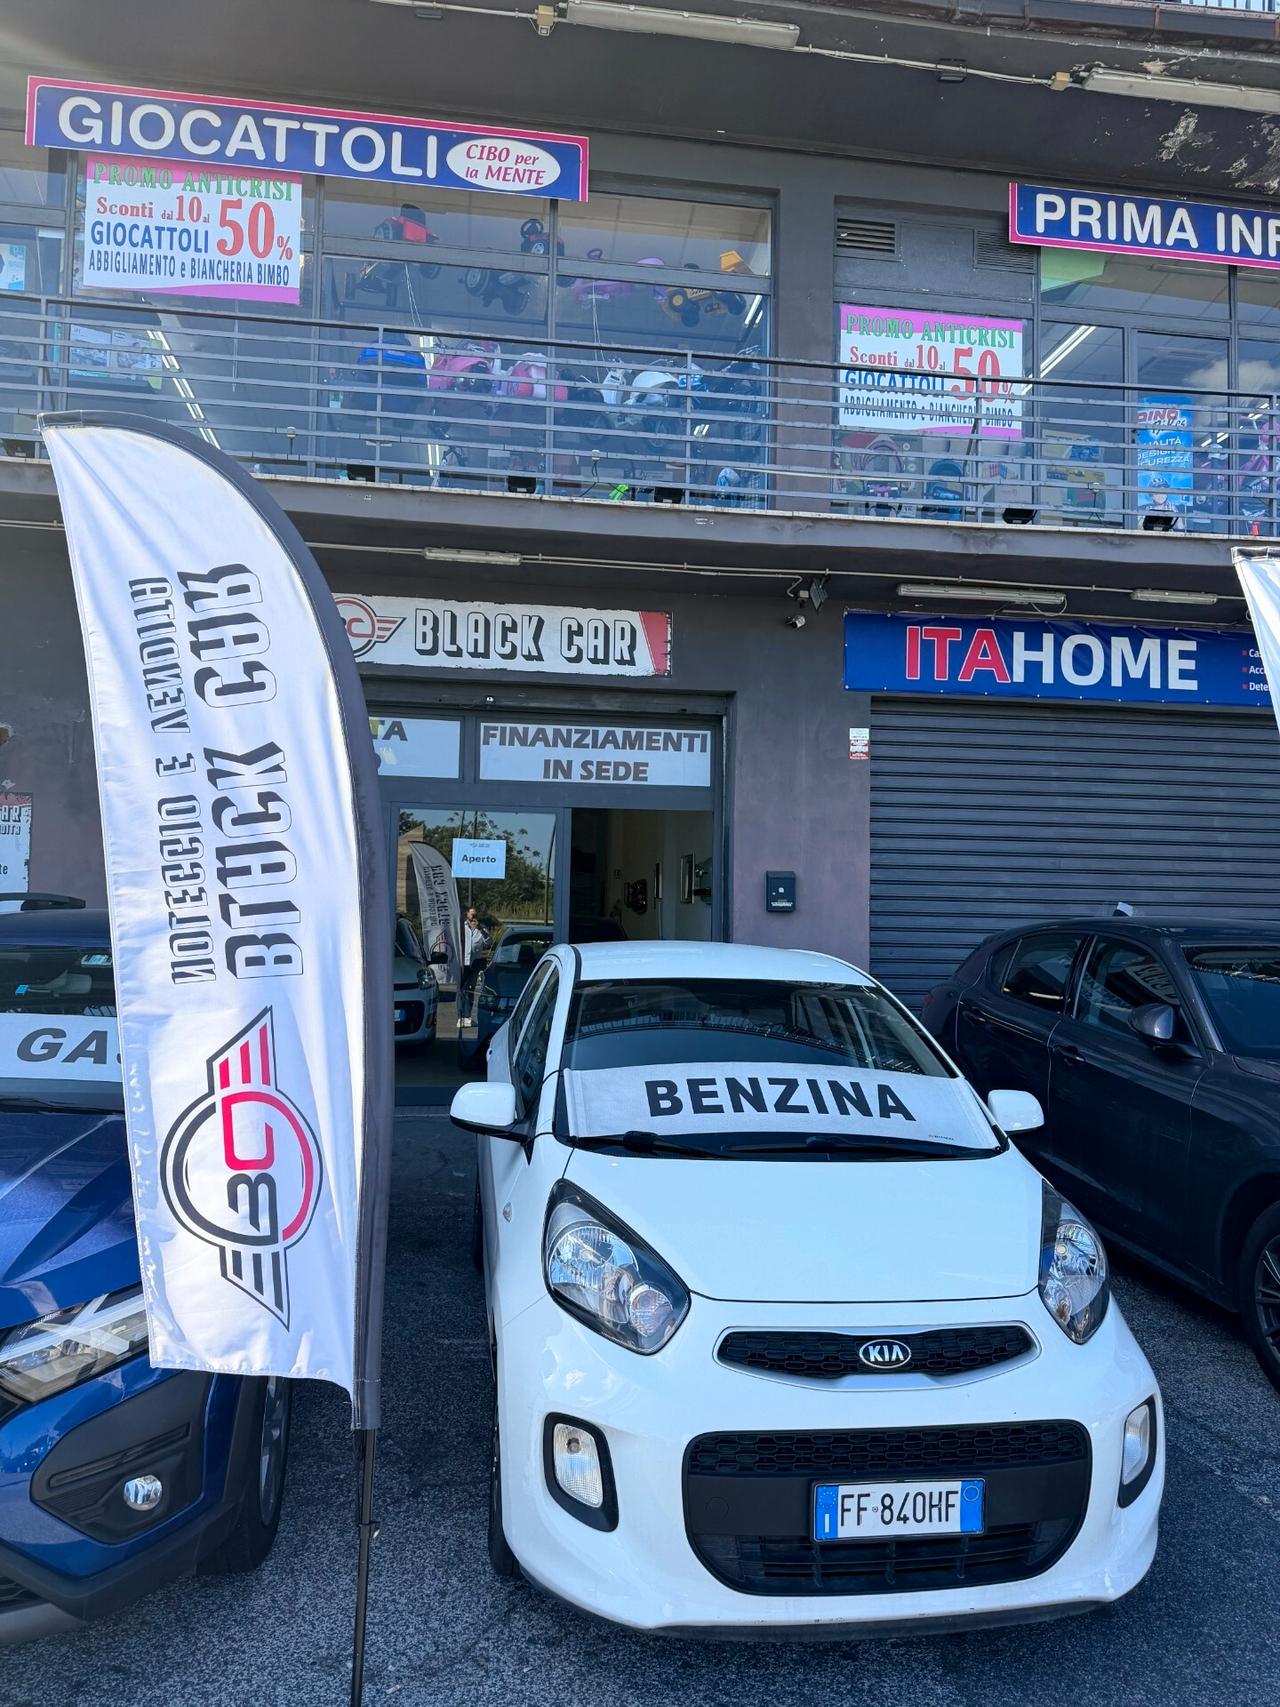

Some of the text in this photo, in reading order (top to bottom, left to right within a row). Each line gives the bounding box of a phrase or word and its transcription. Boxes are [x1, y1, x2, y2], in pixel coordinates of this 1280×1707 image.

[58, 96, 438, 178] GIOCATTOLI
[466, 144, 539, 166] CIBO per
[93, 162, 292, 201] PROMO ANTICRISI
[465, 165, 546, 185] la MENTE
[96, 197, 154, 219] Sconti
[161, 209, 174, 221] dal
[176, 195, 202, 223] 10
[202, 214, 210, 224] al
[1035, 193, 1199, 248] PRIMA
[90, 220, 209, 253] GIOCATTOLI
[89, 249, 290, 286] ABBIGLIAMENTO e BIANCHERIA BIMBO
[846, 314, 1015, 349] PROMO ANTICRISI
[850, 346, 898, 367] Sconti
[904, 357, 915, 368] dal
[916, 344, 939, 371] 10
[845, 369, 946, 399] GIOCATTOLI
[414, 608, 545, 662] BLACK
[560, 617, 637, 666] CAR
[905, 625, 1198, 691] ITAHOME
[1249, 665, 1265, 674] Acc
[1249, 682, 1270, 691] Dete
[481, 725, 708, 753] FINANZIAMENTI
[543, 759, 649, 782] IN SEDE
[0, 804, 21, 822] AR
[461, 854, 497, 864] Aperto
[17, 1027, 121, 1064] GA
[644, 1077, 916, 1122] BENZINA
[868, 1344, 905, 1362] KIA
